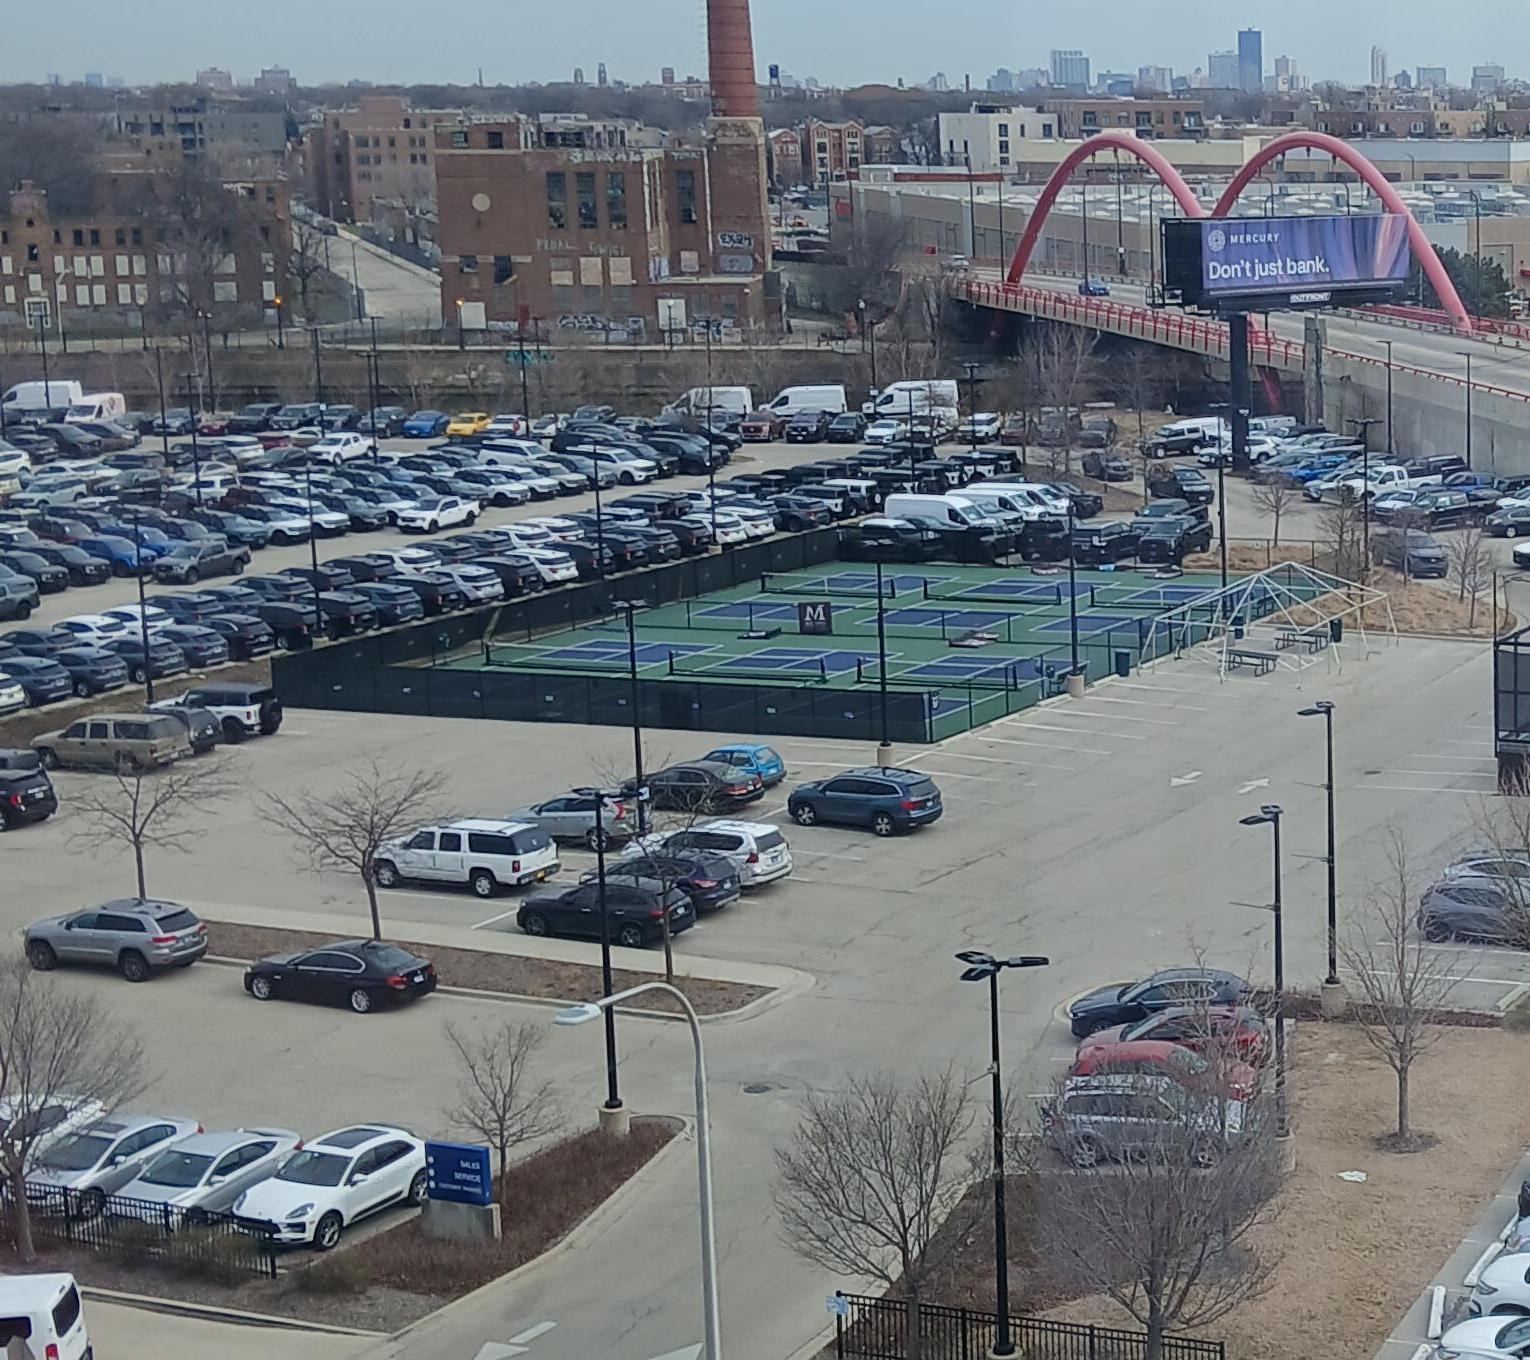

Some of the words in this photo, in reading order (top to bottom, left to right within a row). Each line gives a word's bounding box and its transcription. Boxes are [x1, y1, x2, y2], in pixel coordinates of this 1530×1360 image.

[1229, 233, 1280, 245] MERCURY
[1208, 259, 1252, 279] Don't
[1253, 258, 1283, 280] just
[1286, 256, 1330, 275] bank.
